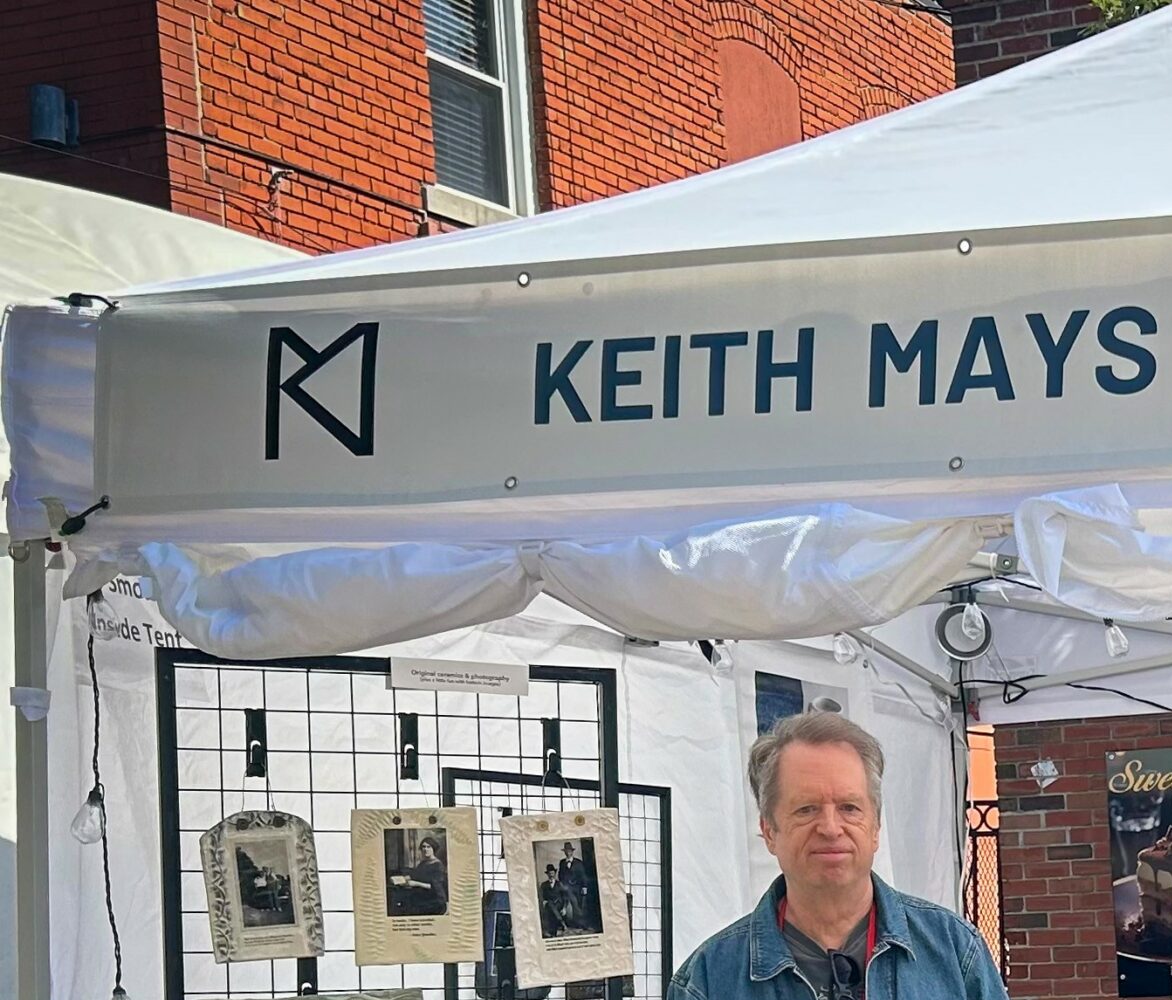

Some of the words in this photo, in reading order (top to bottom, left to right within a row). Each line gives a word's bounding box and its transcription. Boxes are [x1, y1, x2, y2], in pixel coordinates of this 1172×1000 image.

[533, 326, 815, 425] KEITH
[868, 306, 1158, 408] MAYS
[410, 669, 436, 678] Original
[437, 671, 464, 679] ceramics
[470, 674, 510, 682] photography
